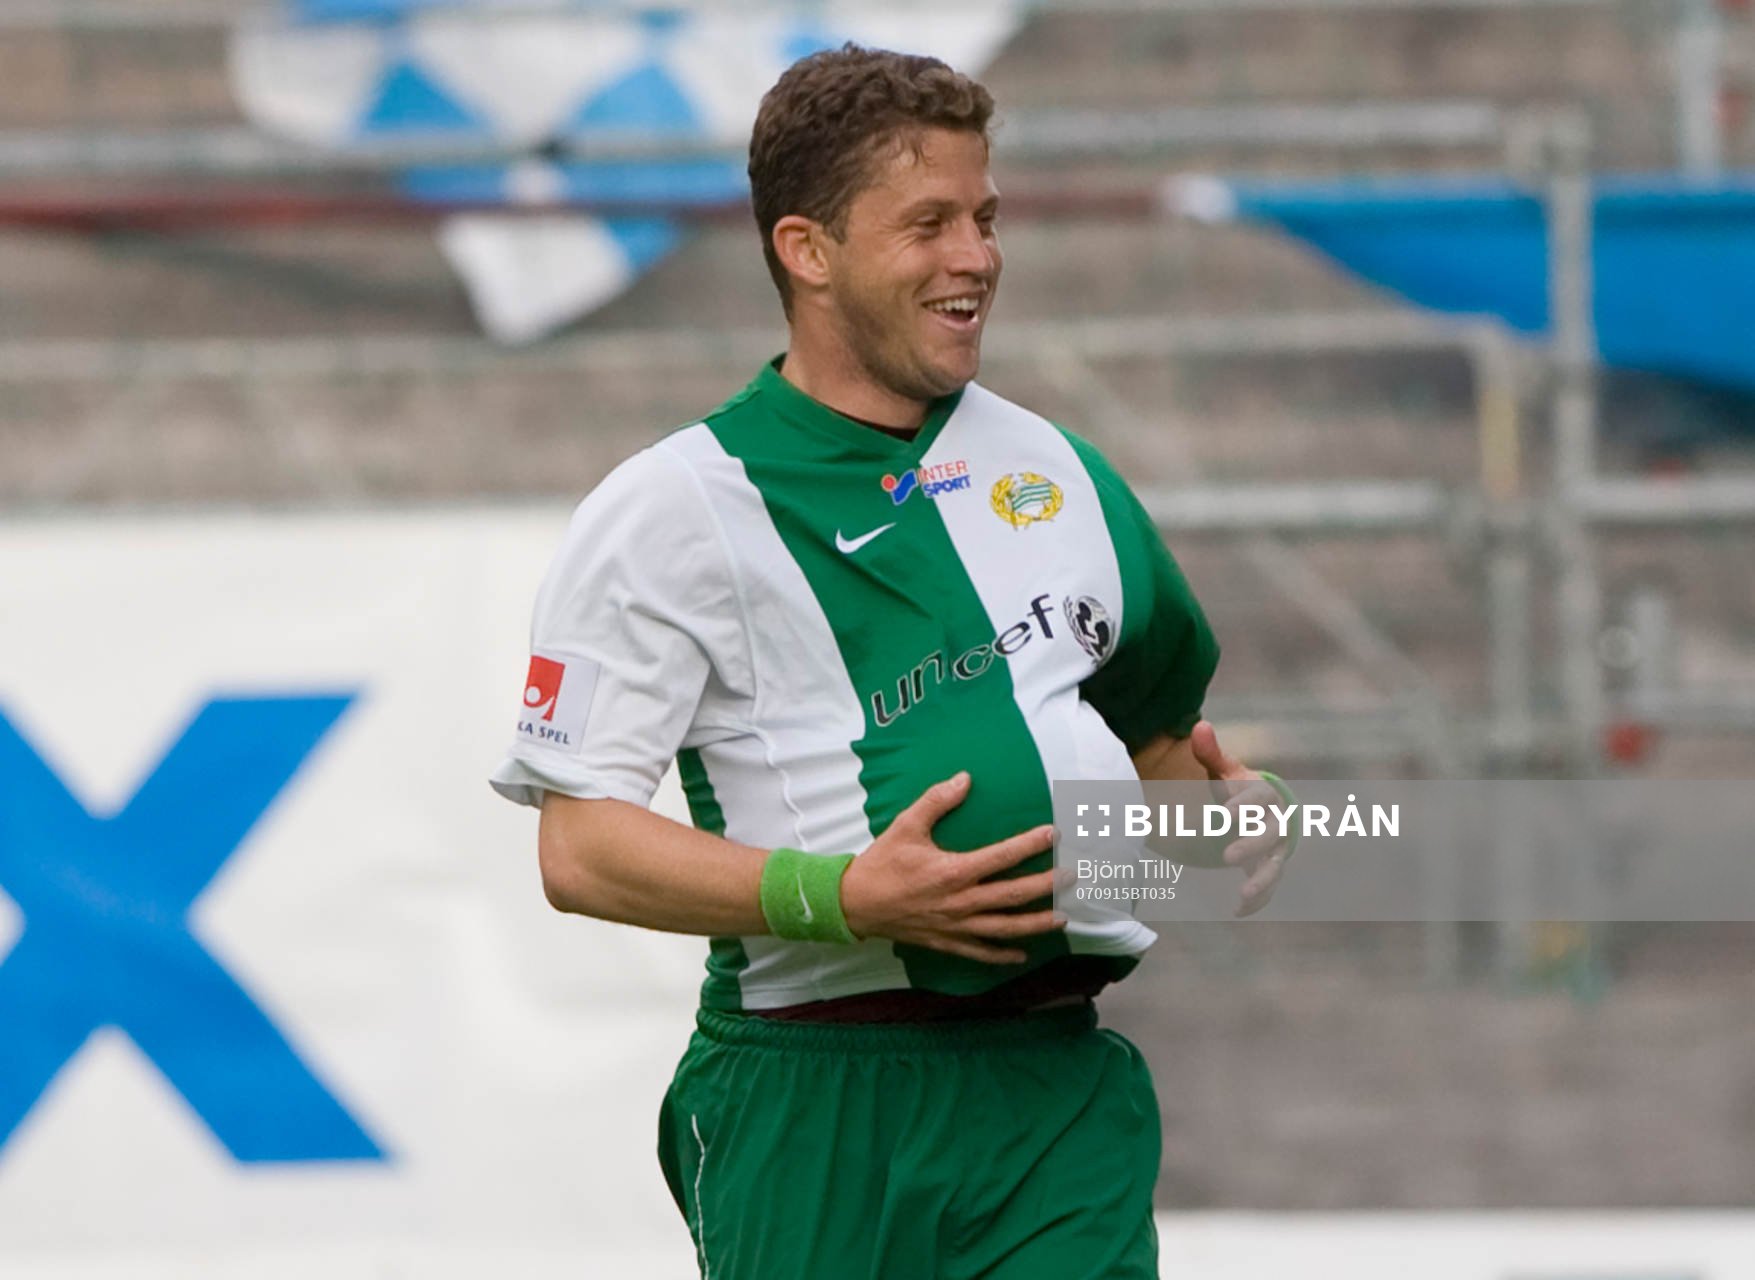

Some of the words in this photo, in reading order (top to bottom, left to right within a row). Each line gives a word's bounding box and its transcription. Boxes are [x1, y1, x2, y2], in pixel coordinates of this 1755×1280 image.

[917, 459, 969, 482] INTER
[922, 474, 972, 497] SPORT
[871, 593, 1055, 728] uncef
[538, 725, 571, 746] SPEL
